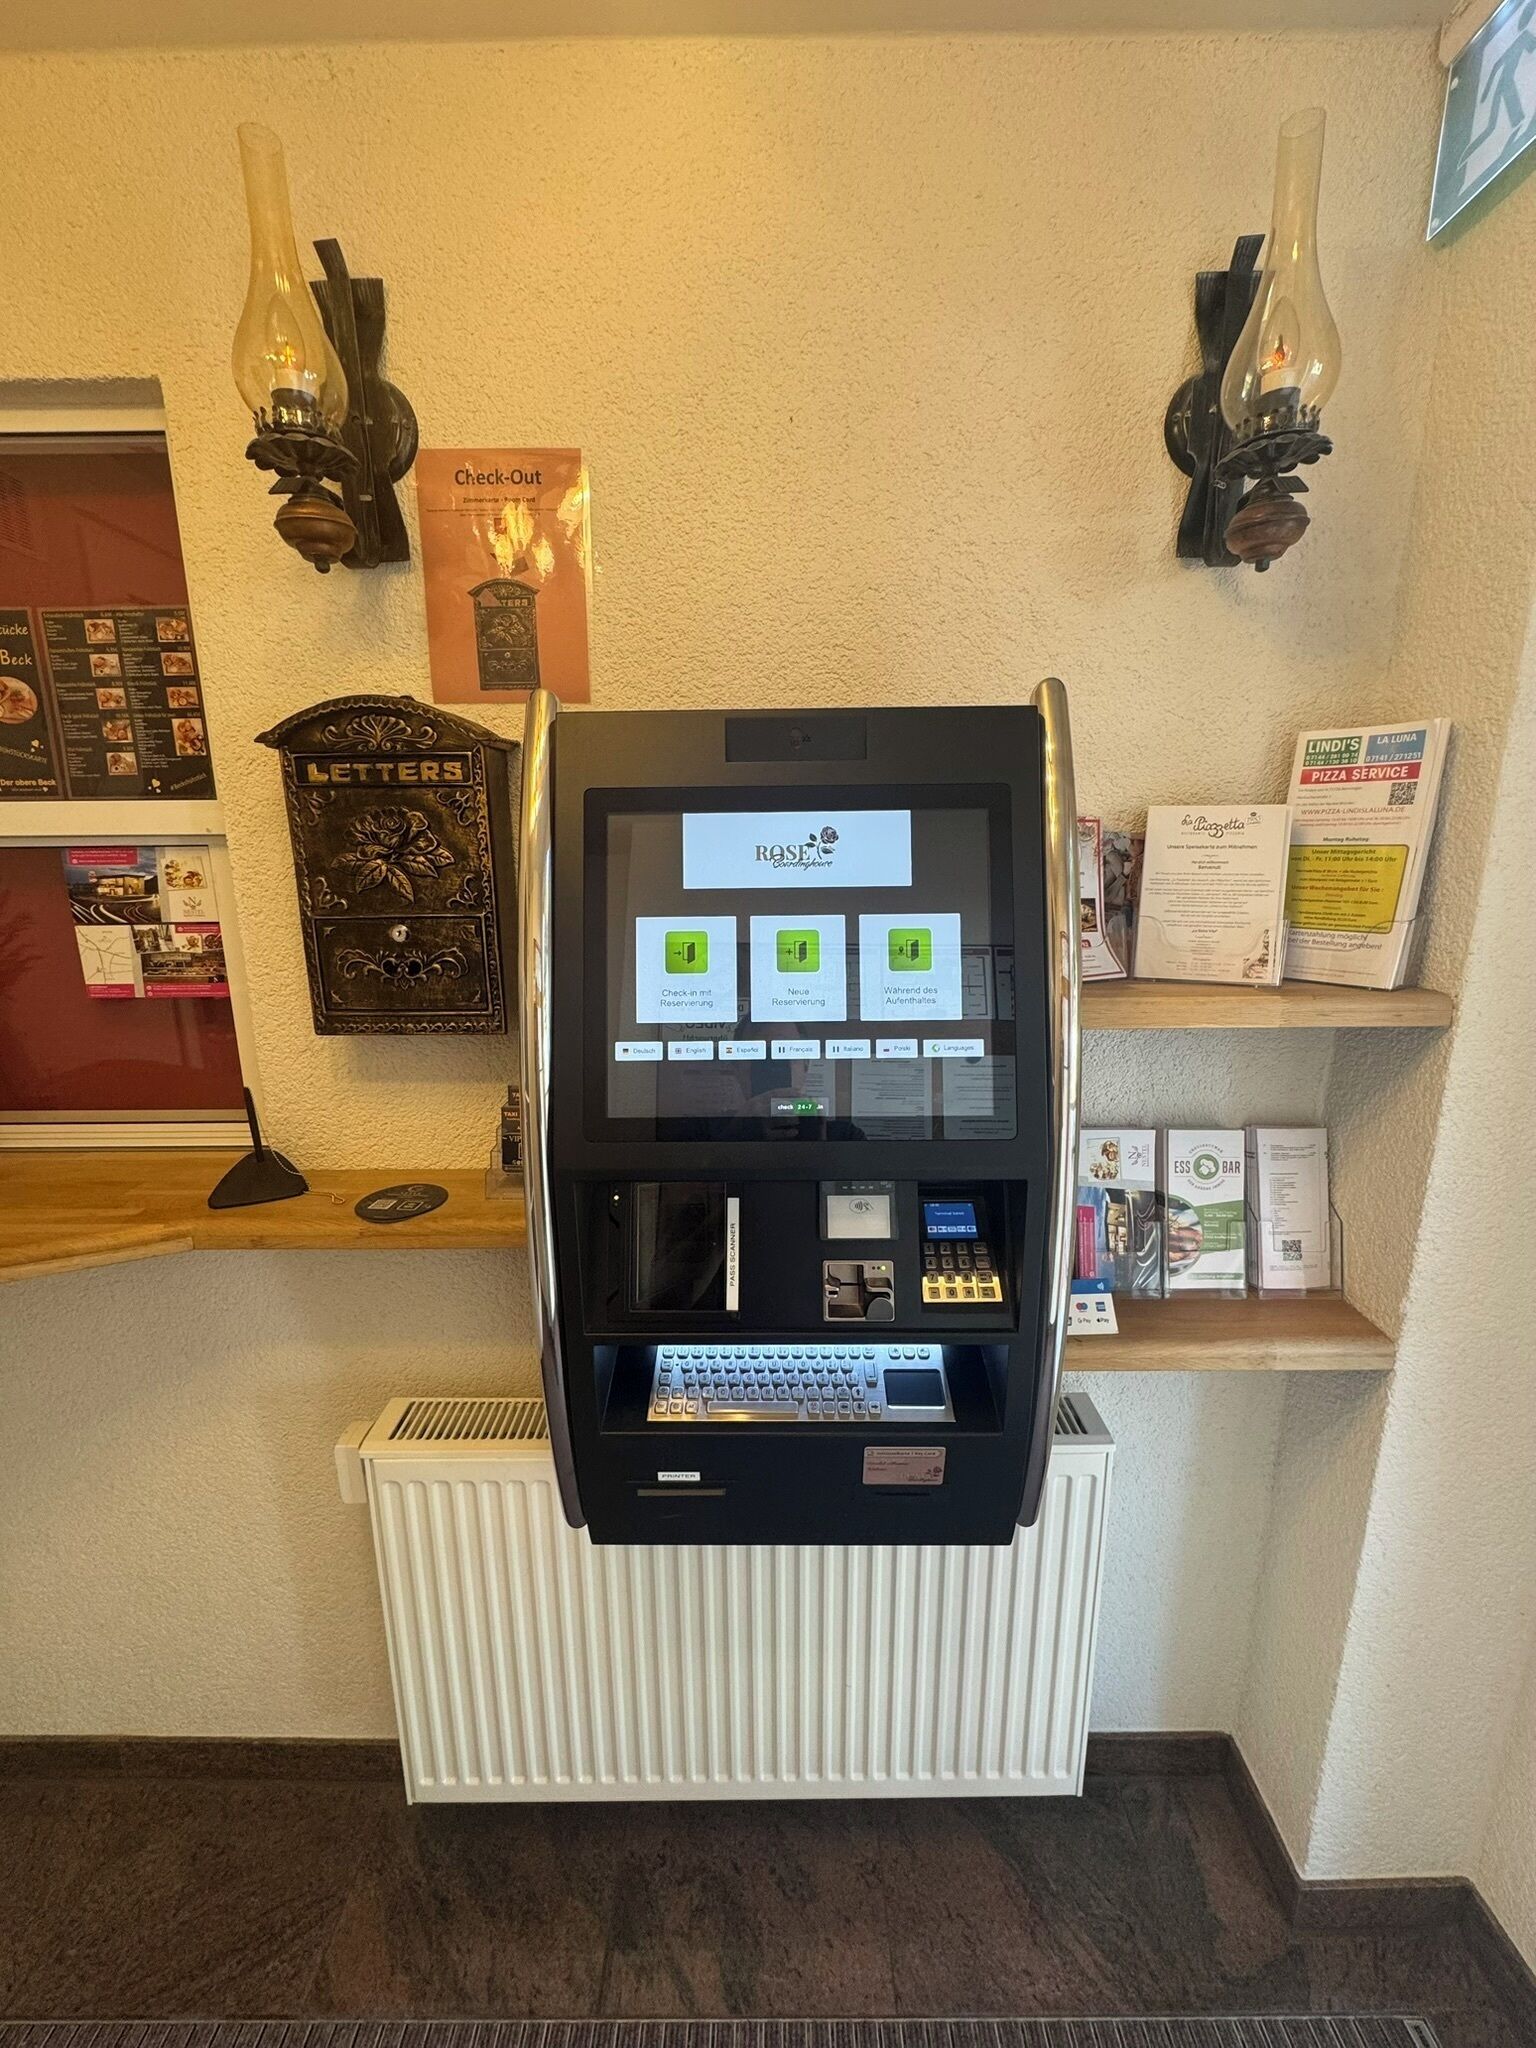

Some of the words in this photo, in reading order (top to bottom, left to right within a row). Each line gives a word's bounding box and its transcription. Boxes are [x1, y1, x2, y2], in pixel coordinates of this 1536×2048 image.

[454, 468, 542, 486] Check-Out
[0, 649, 33, 666] Beck
[1308, 737, 1360, 753] LINDI'S
[1377, 735, 1390, 745] LA
[1391, 733, 1417, 744] LUNA
[306, 760, 464, 785] LETTERS
[1311, 770, 1347, 782] PIZZA
[1352, 766, 1409, 780] SERVICE
[1193, 815, 1245, 839] Piazzetta
[755, 844, 811, 862] ROSE
[661, 988, 698, 997] Check-in
[699, 988, 712, 997] mit
[787, 987, 810, 996] Neue
[883, 986, 921, 995] Während
[922, 985, 938, 995] des
[659, 999, 714, 1009] Reservierung
[771, 997, 826, 1008] Reservierung
[885, 995, 936, 1005] Aufenthaltes
[943, 1044, 975, 1053] Languages
[1174, 1160, 1191, 1174] ESS
[1222, 1160, 1241, 1174] BAR
